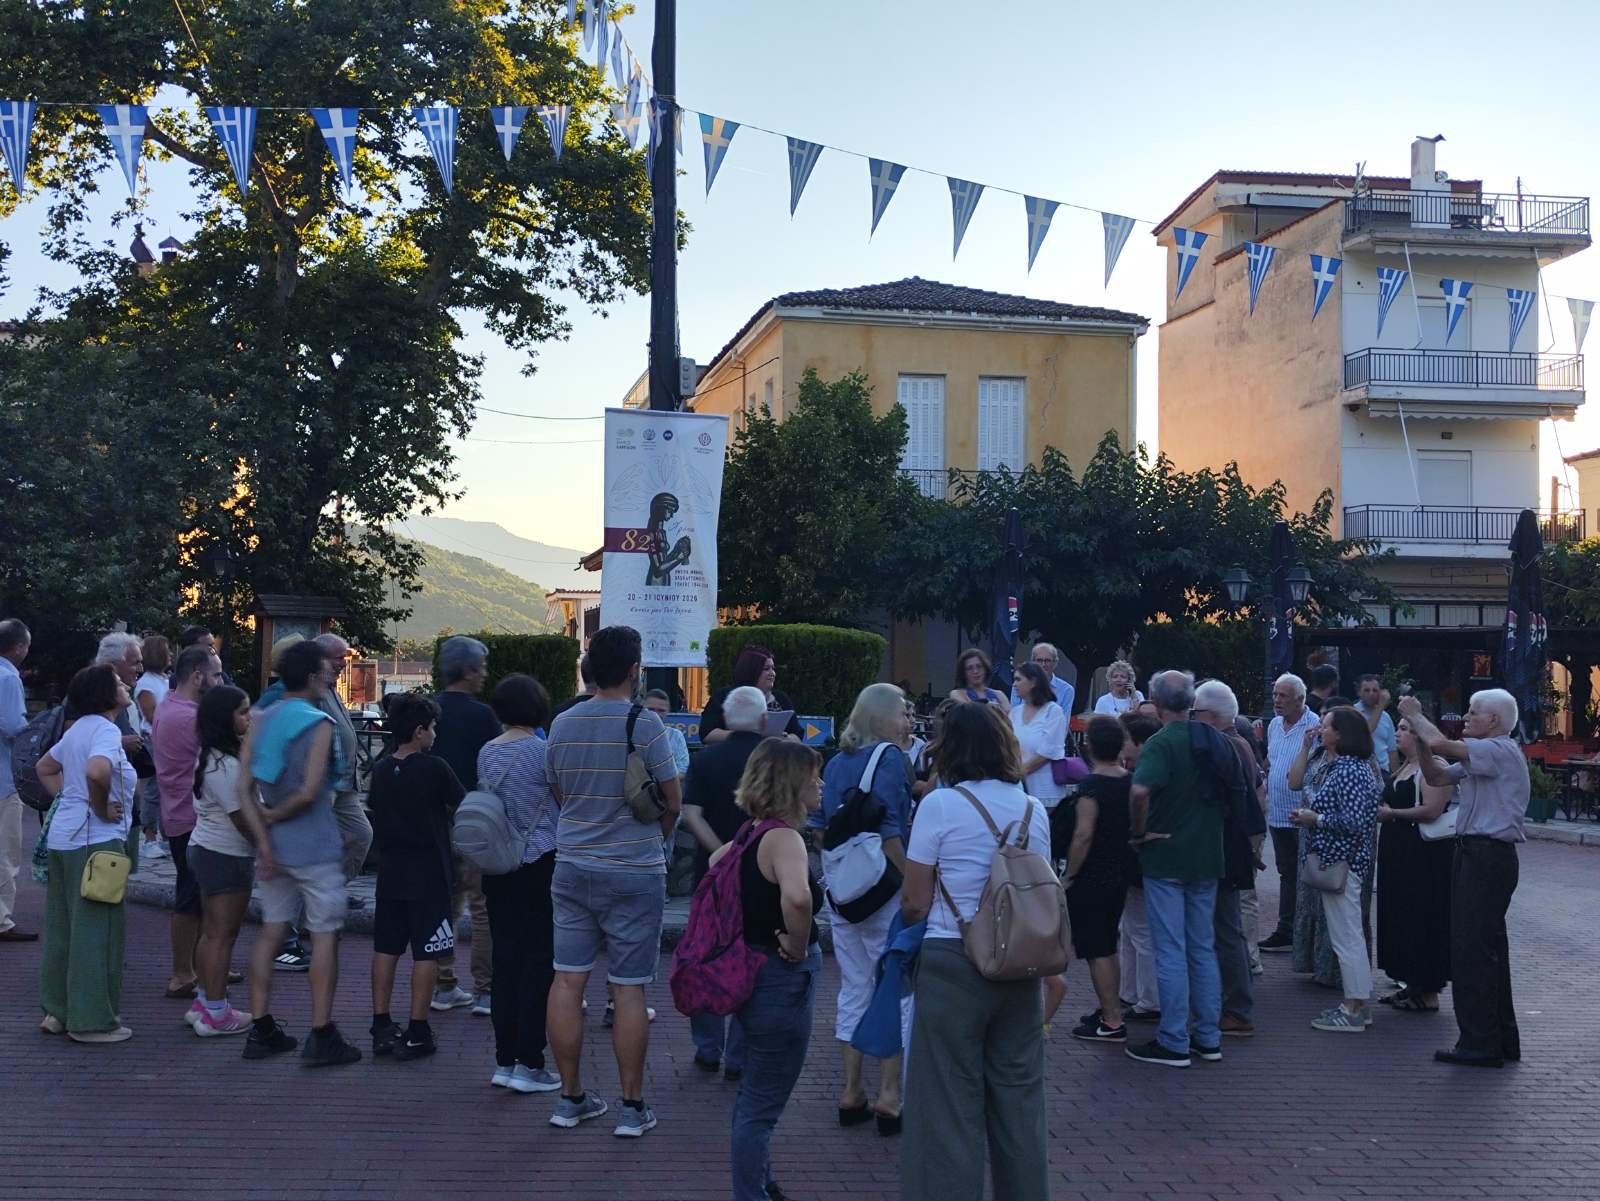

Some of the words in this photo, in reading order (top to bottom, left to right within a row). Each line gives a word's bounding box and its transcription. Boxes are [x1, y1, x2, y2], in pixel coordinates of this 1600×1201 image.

[627, 593, 636, 601] 20
[644, 593, 652, 601] 21
[654, 593, 680, 601] ΙΟΥΝΙΟΥ
[424, 938, 454, 953] adida
